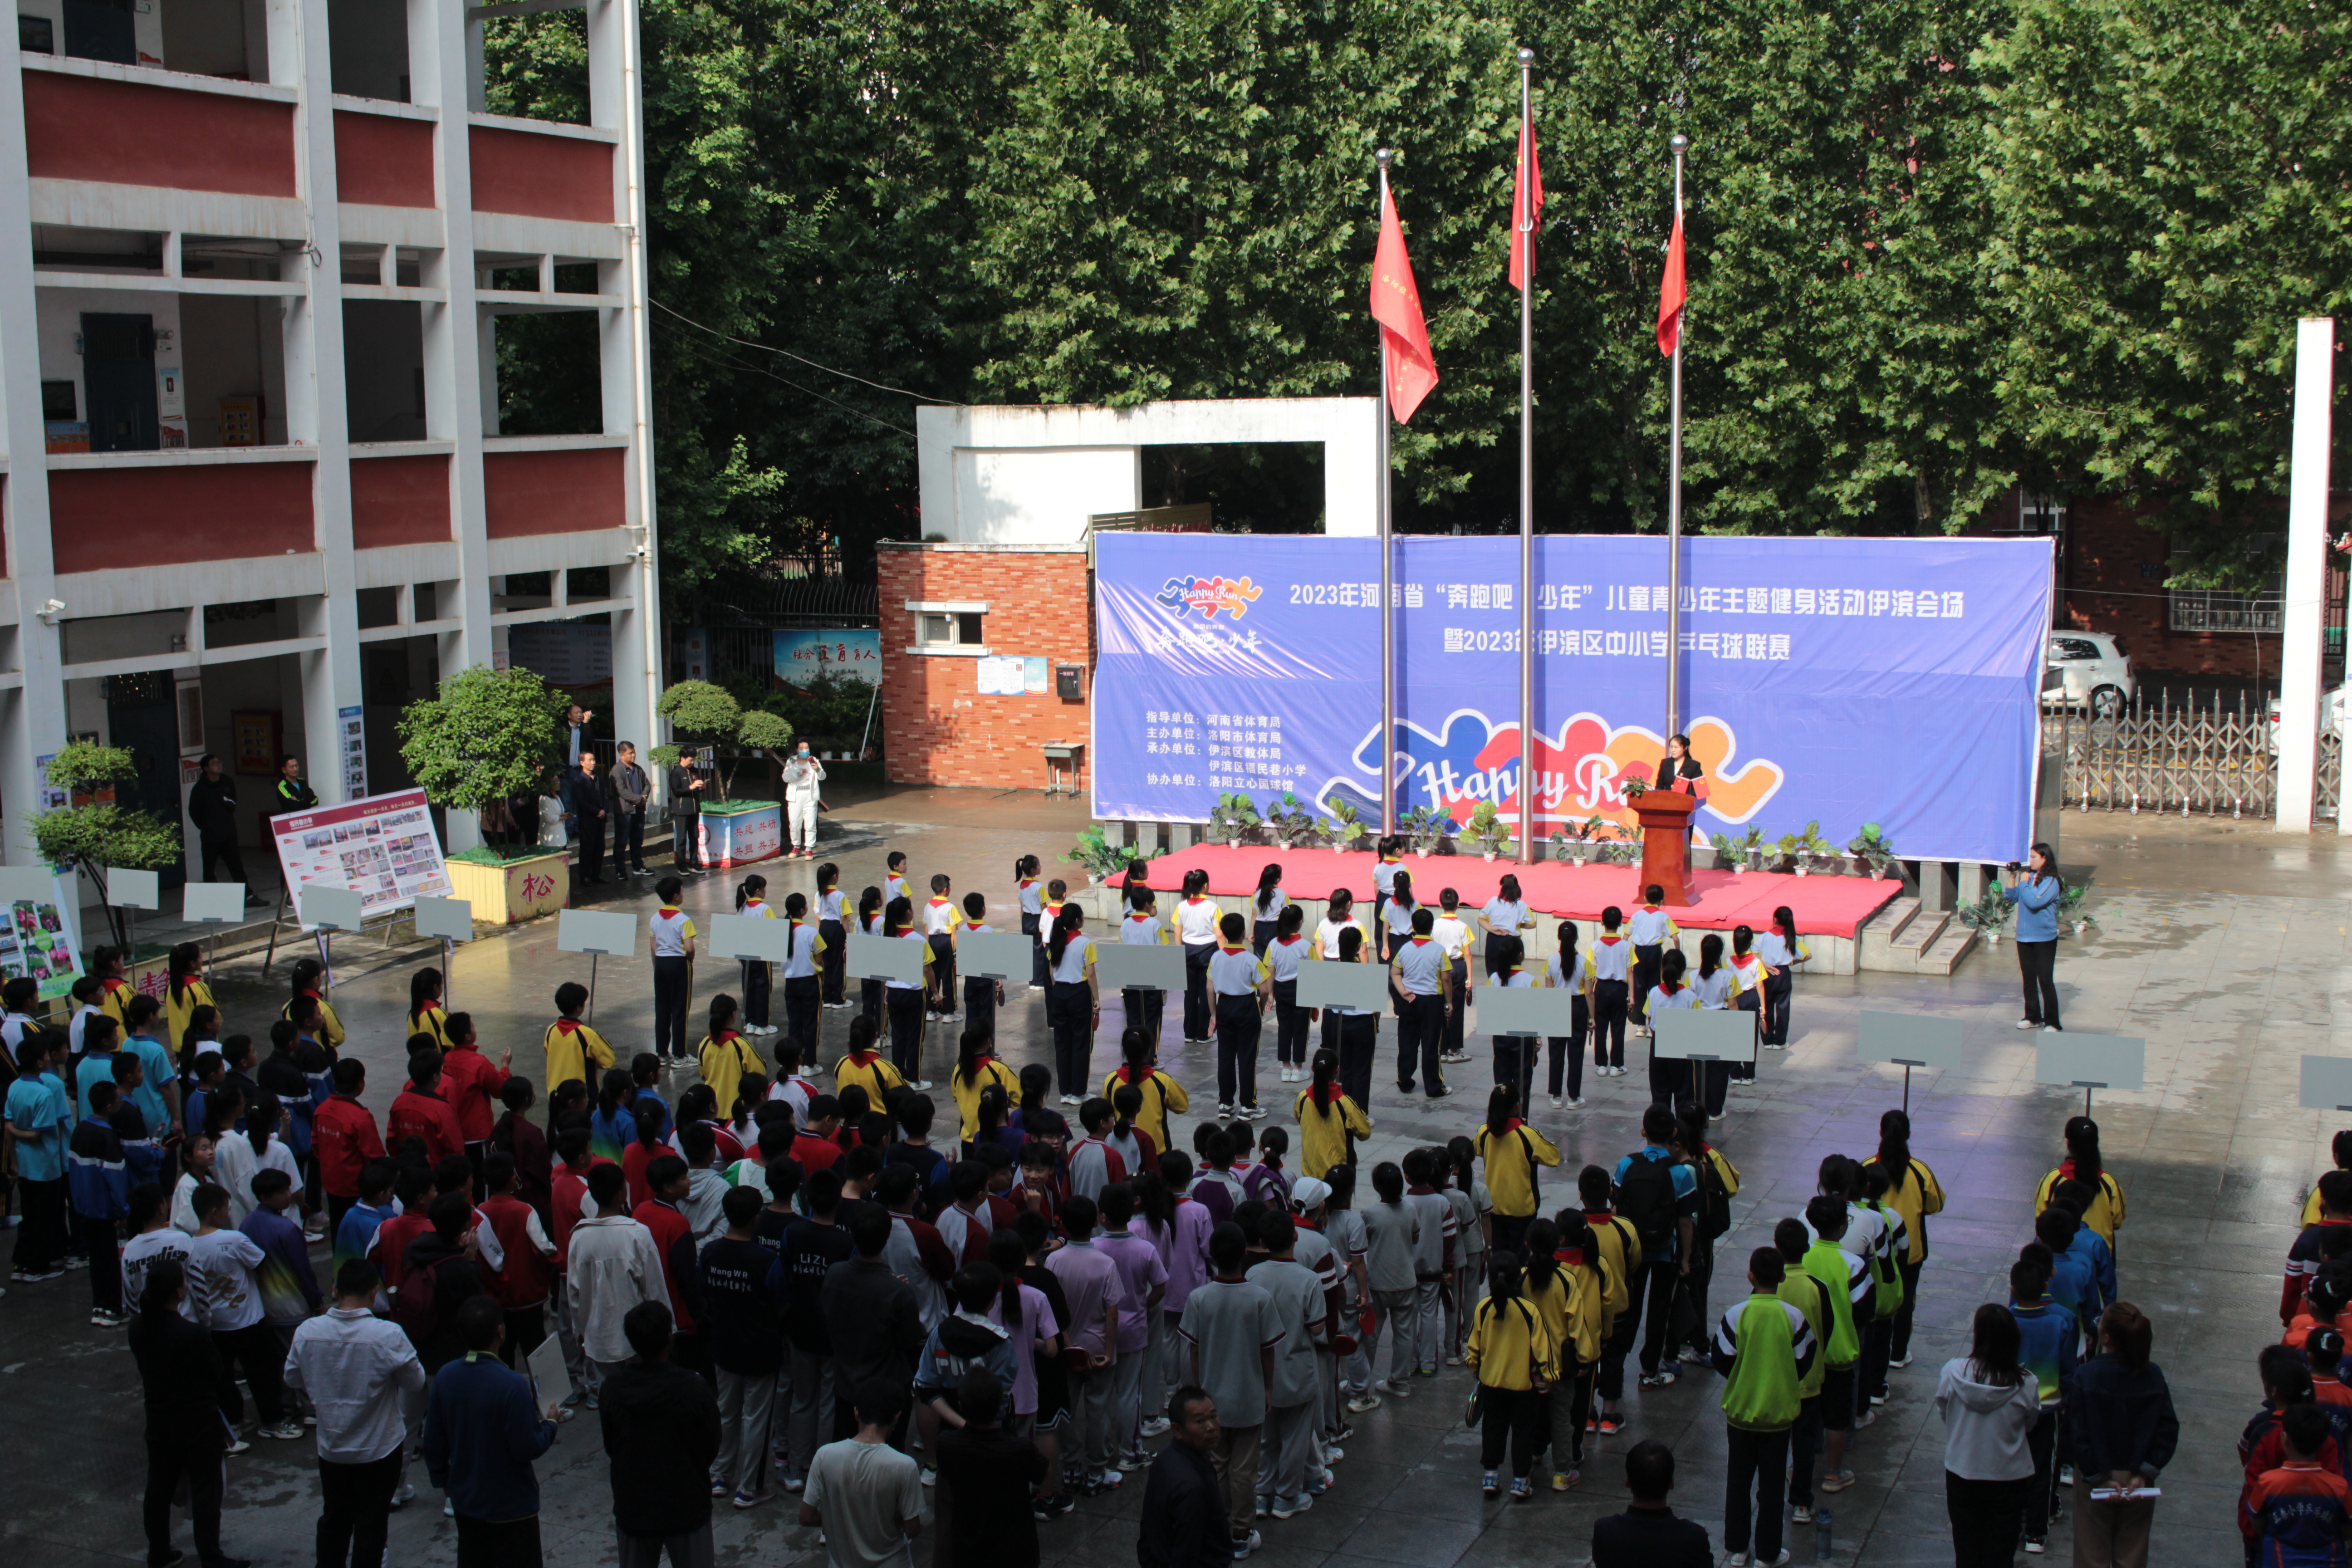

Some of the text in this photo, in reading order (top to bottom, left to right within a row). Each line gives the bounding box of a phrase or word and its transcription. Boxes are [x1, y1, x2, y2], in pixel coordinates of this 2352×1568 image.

[1179, 585, 1238, 602] Happy Run
[1290, 582, 1965, 618] 2023年河南省“奔跑吧少年”儿童青少年主题健身活动伊滨会场
[1209, 760, 1306, 777] 伊滨区福民巷小学
[1416, 759, 1569, 815] Happy
[735, 819, 776, 838] 共建 共研
[735, 838, 776, 857] 共担 共享
[522, 872, 555, 903] 松
